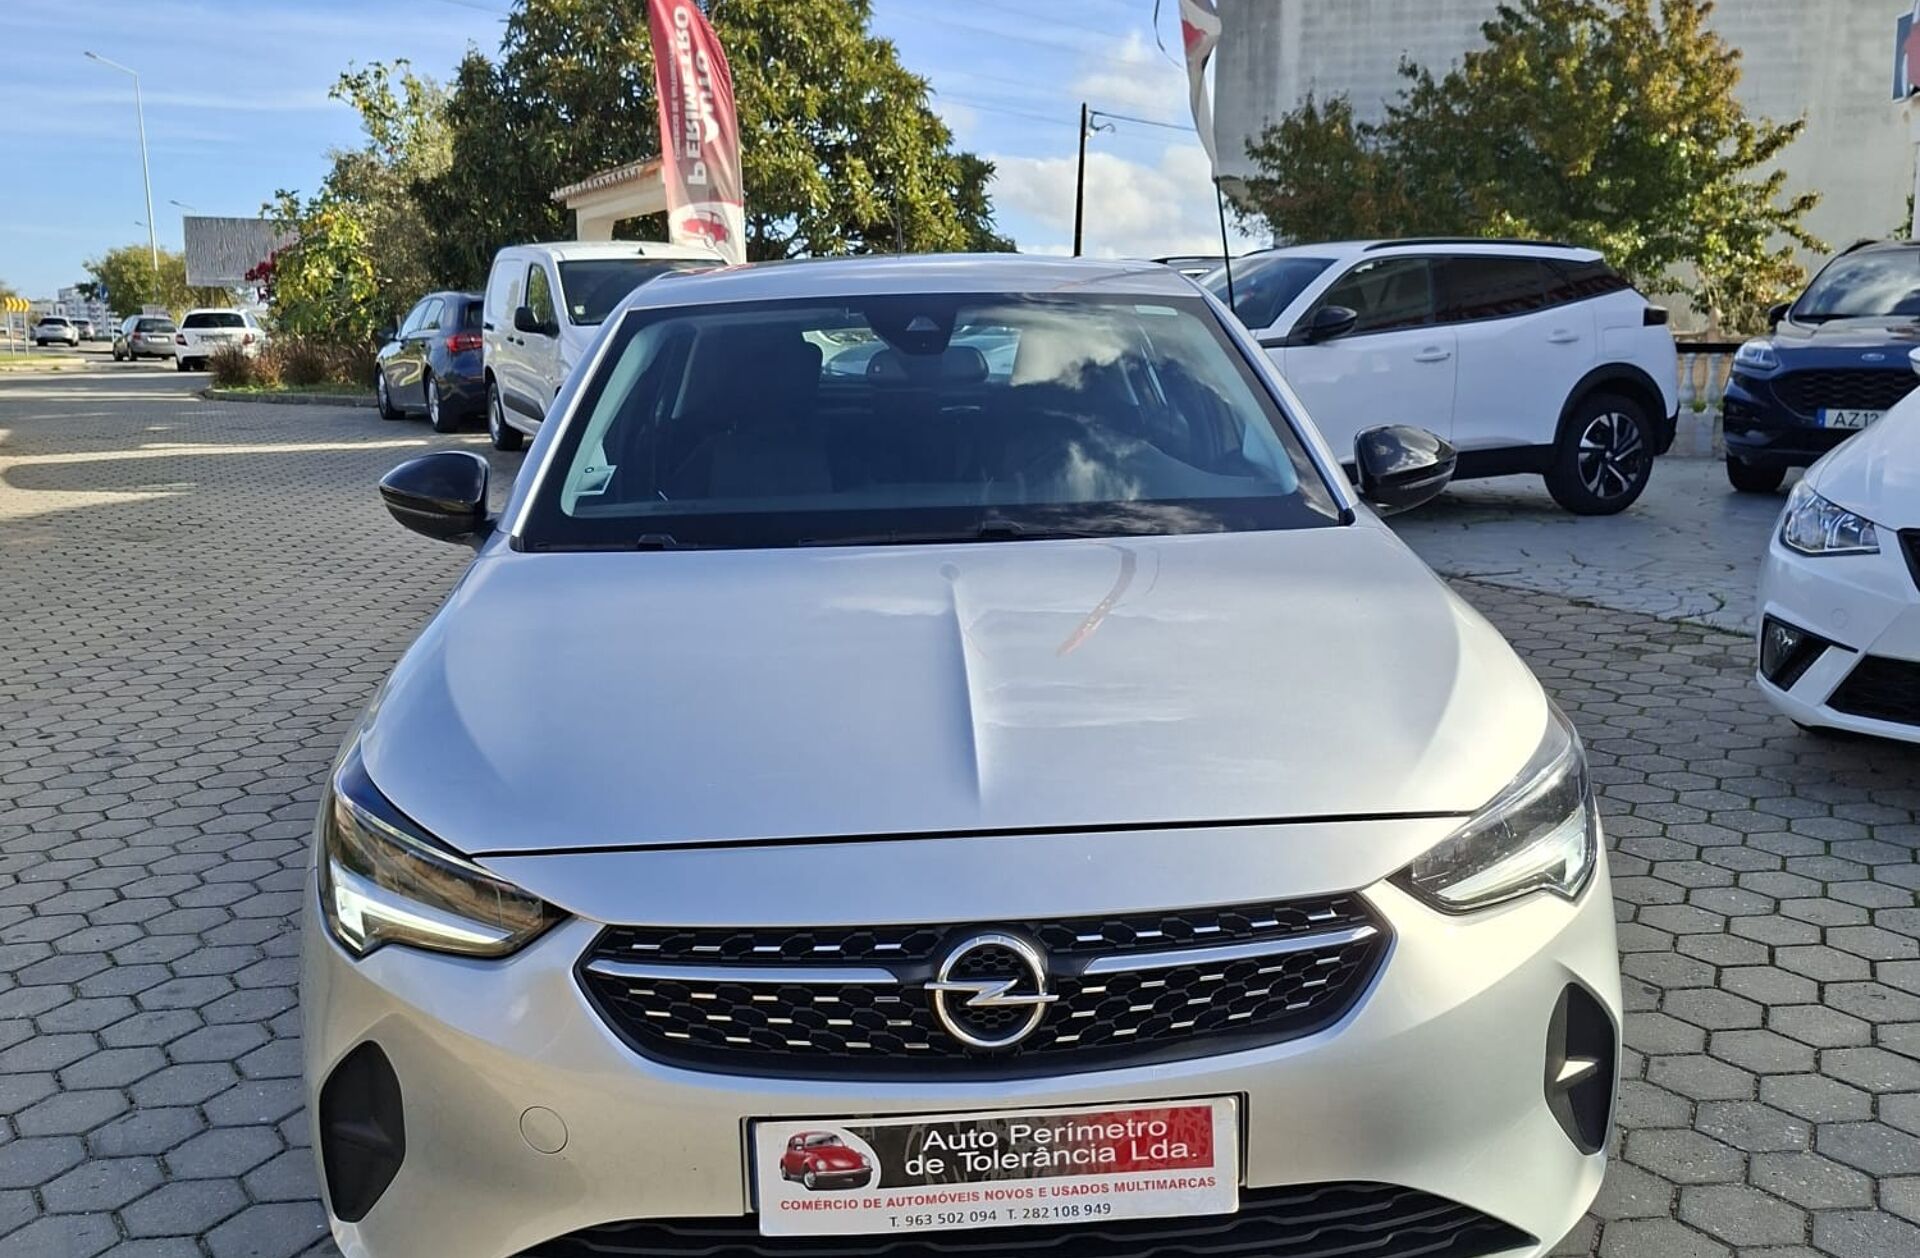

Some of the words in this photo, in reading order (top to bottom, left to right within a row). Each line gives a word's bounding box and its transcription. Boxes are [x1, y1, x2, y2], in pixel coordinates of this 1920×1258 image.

[923, 1129, 998, 1151] Auto
[1009, 1118, 1167, 1145] Perímetro
[905, 1153, 945, 1176] de
[957, 1143, 1116, 1173] Tolerância
[1131, 1139, 1198, 1162] Lda.
[781, 1196, 858, 1210] COMÉRCIO
[863, 1199, 882, 1209] DE
[886, 1191, 980, 1208] AUTOMÓVEIS
[984, 1187, 1034, 1201] NOVOS
[1038, 1187, 1047, 1198] E
[1051, 1183, 1110, 1197] USADOS
[1114, 1176, 1217, 1193] MULTIMARCAS
[889, 1216, 900, 1228] T.
[905, 1214, 932, 1227] 963
[937, 1212, 964, 1225] 502
[969, 1210, 997, 1223] 094
[1007, 1208, 1017, 1220] T.
[1022, 1207, 1049, 1220] 282
[1052, 1205, 1080, 1218] 108
[1084, 1203, 1111, 1216] 949
